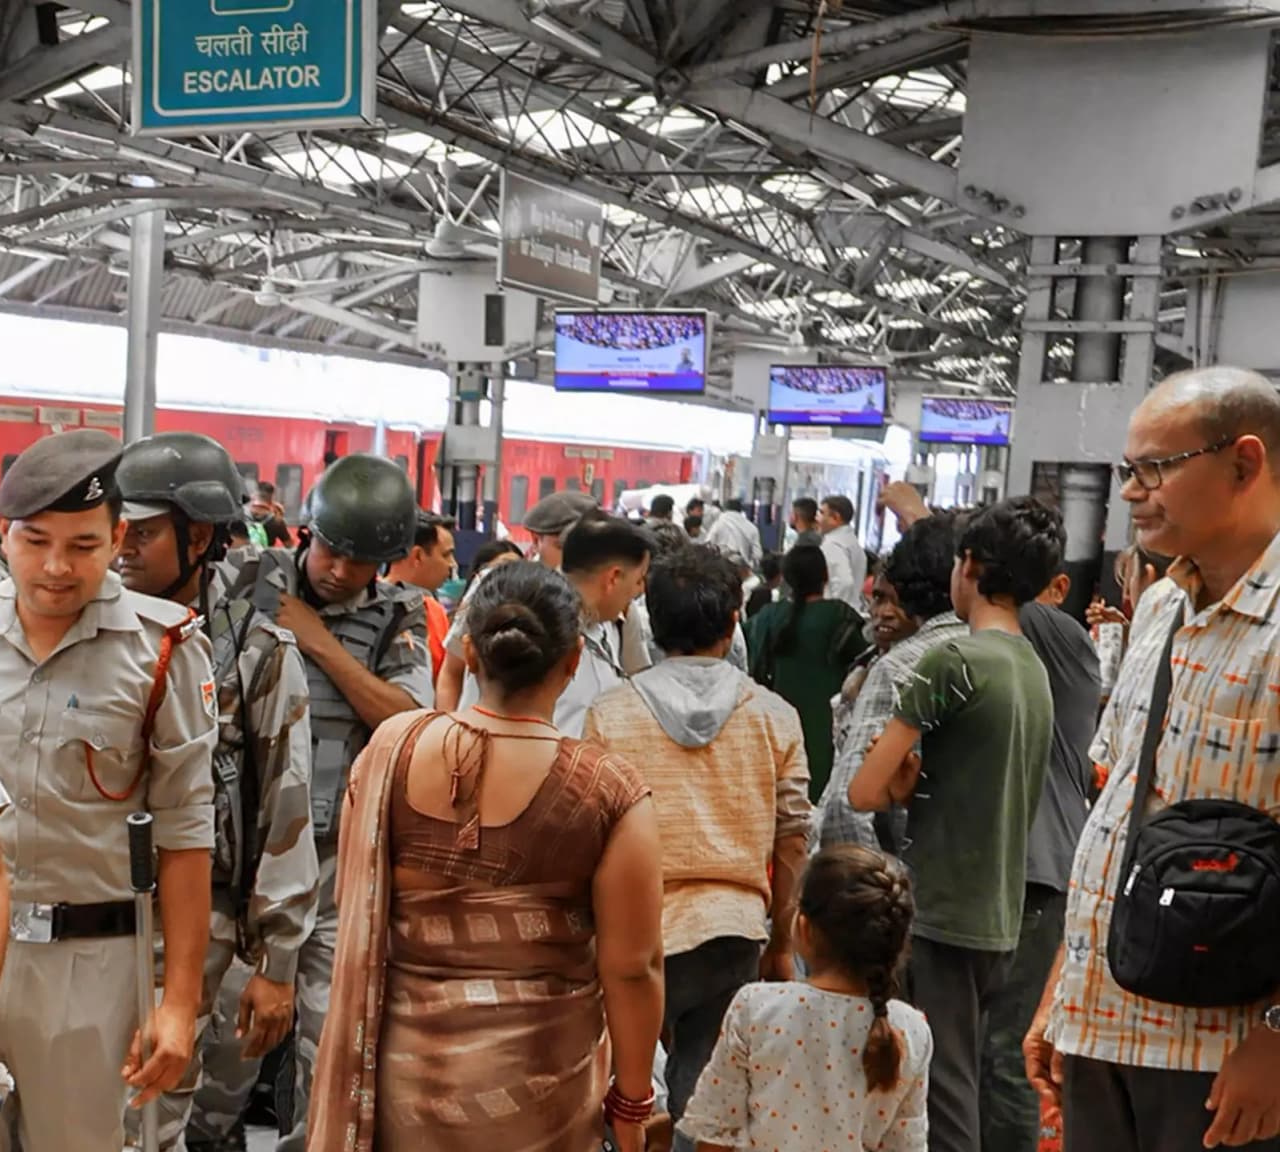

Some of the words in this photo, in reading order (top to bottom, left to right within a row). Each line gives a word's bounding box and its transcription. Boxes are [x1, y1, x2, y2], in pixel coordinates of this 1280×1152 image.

[195, 25, 253, 57] चलती
[260, 22, 309, 56] सीढ़ी
[184, 65, 320, 94] ESCALATOR
